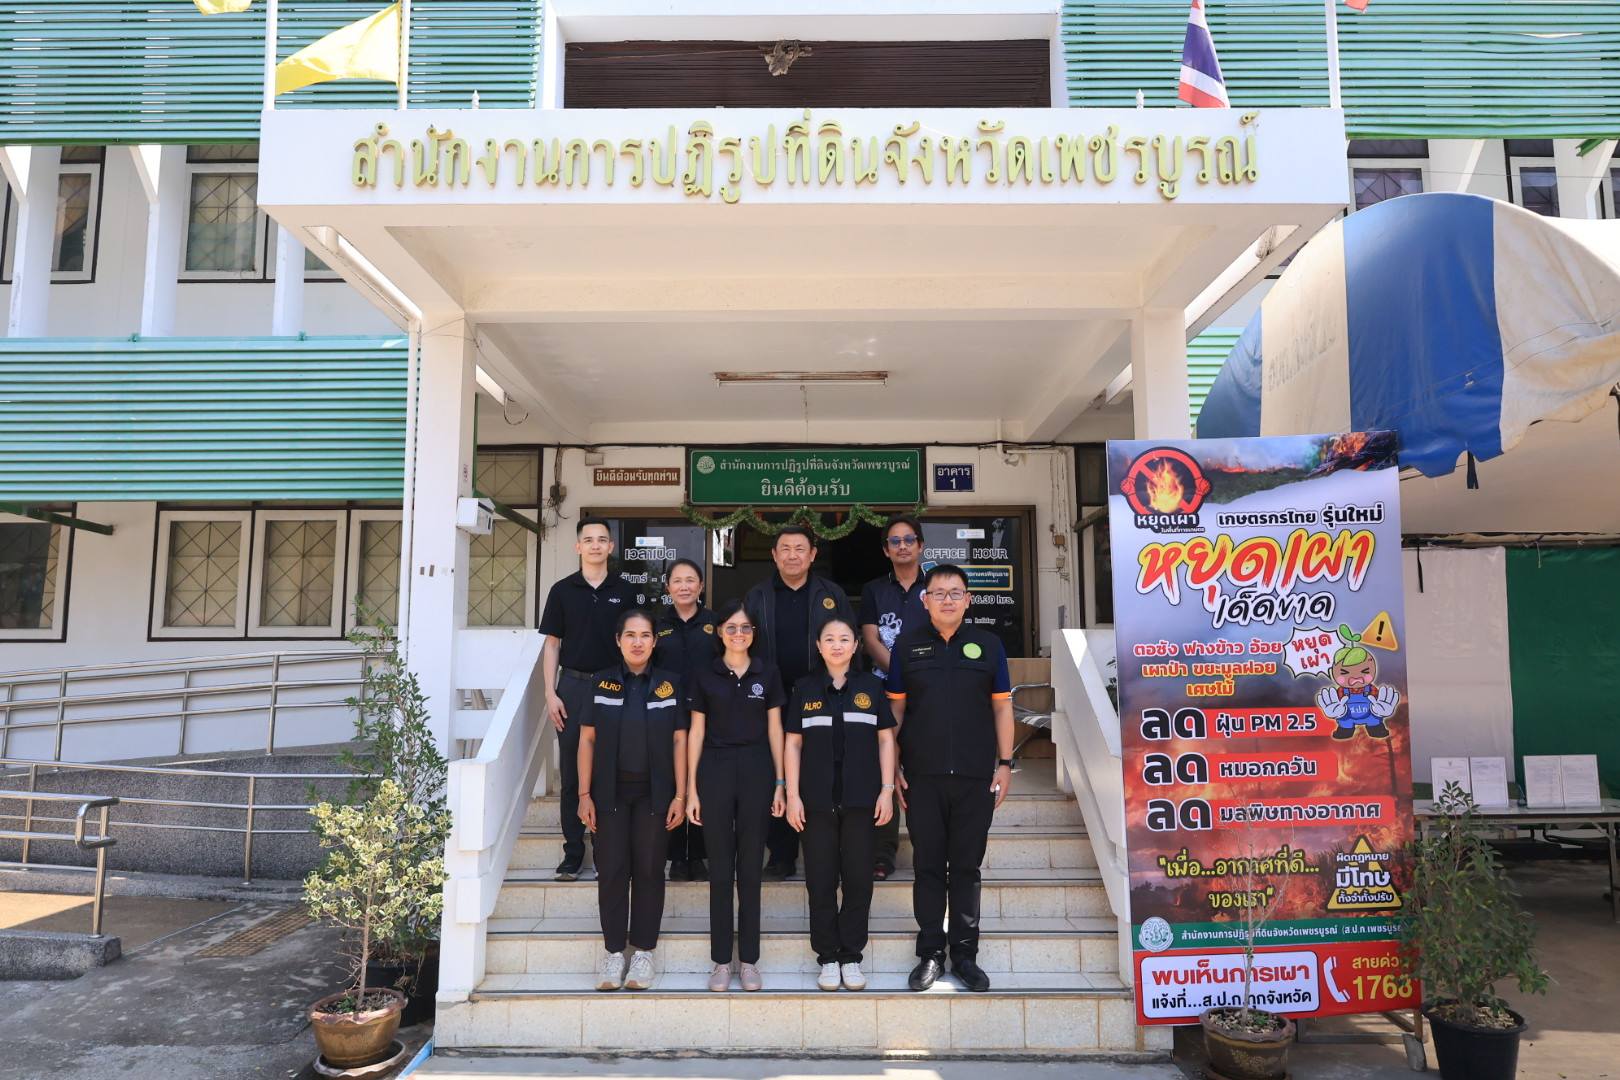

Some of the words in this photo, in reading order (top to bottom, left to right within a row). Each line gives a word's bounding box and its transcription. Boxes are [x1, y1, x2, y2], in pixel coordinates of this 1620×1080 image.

[351, 109, 1259, 204] สำนักงานการปฏิรูปที่ดินจังหวัดเพชรบูรณ์
[720, 454, 911, 474] สำนักงานการปฏิรูปที่ดินจังหวัดเพชรบูรณ์
[937, 467, 971, 477] อาคาร
[596, 469, 678, 484] ยินดีต้อนรับทุกท่าน
[950, 477, 957, 490] 1
[761, 477, 850, 496] ยินดีต้อนรับ
[1137, 514, 1197, 530] หยุดเผา
[1218, 510, 1317, 526] เกษตรกรไทย
[1322, 503, 1384, 528] รุ่นใหม่
[624, 546, 677, 561] เวลาเปิด
[924, 548, 966, 560] OFFICE
[972, 548, 1009, 560] HOUR
[1139, 531, 1371, 606] หยุดเผา
[1215, 589, 1334, 625] เด็ดขาด
[1134, 640, 1179, 656] ตอซัง
[1184, 639, 1244, 656] ฟางข้าว
[1250, 638, 1283, 655] อ้อย
[1291, 634, 1332, 654] หยุด
[1142, 661, 1188, 677] เผาป่า
[1193, 660, 1277, 679] ขยะมูลฝอย
[1300, 652, 1331, 669] เผา
[599, 680, 621, 692] ALRO
[1186, 680, 1235, 696] เศษไม้
[804, 701, 822, 711] ALRO
[1140, 707, 1208, 741] ลด
[1215, 713, 1245, 737] ฝุ่น
[1251, 714, 1282, 732] PM
[1287, 713, 1317, 731] 2.5
[1142, 751, 1209, 785] ลด
[1219, 757, 1317, 777] หมอกควัน
[1146, 798, 1213, 831] ลด
[1219, 803, 1381, 823] มลพิษทางอากาศ
[1336, 853, 1389, 863] ผิดกฎหมาย
[1336, 866, 1391, 888] มีโทษ
[1338, 890, 1393, 903] ทั้งจำทั้งปรับ
[1352, 952, 1408, 969] สายด่ว
[1151, 959, 1310, 986] พบเห็นการเผา
